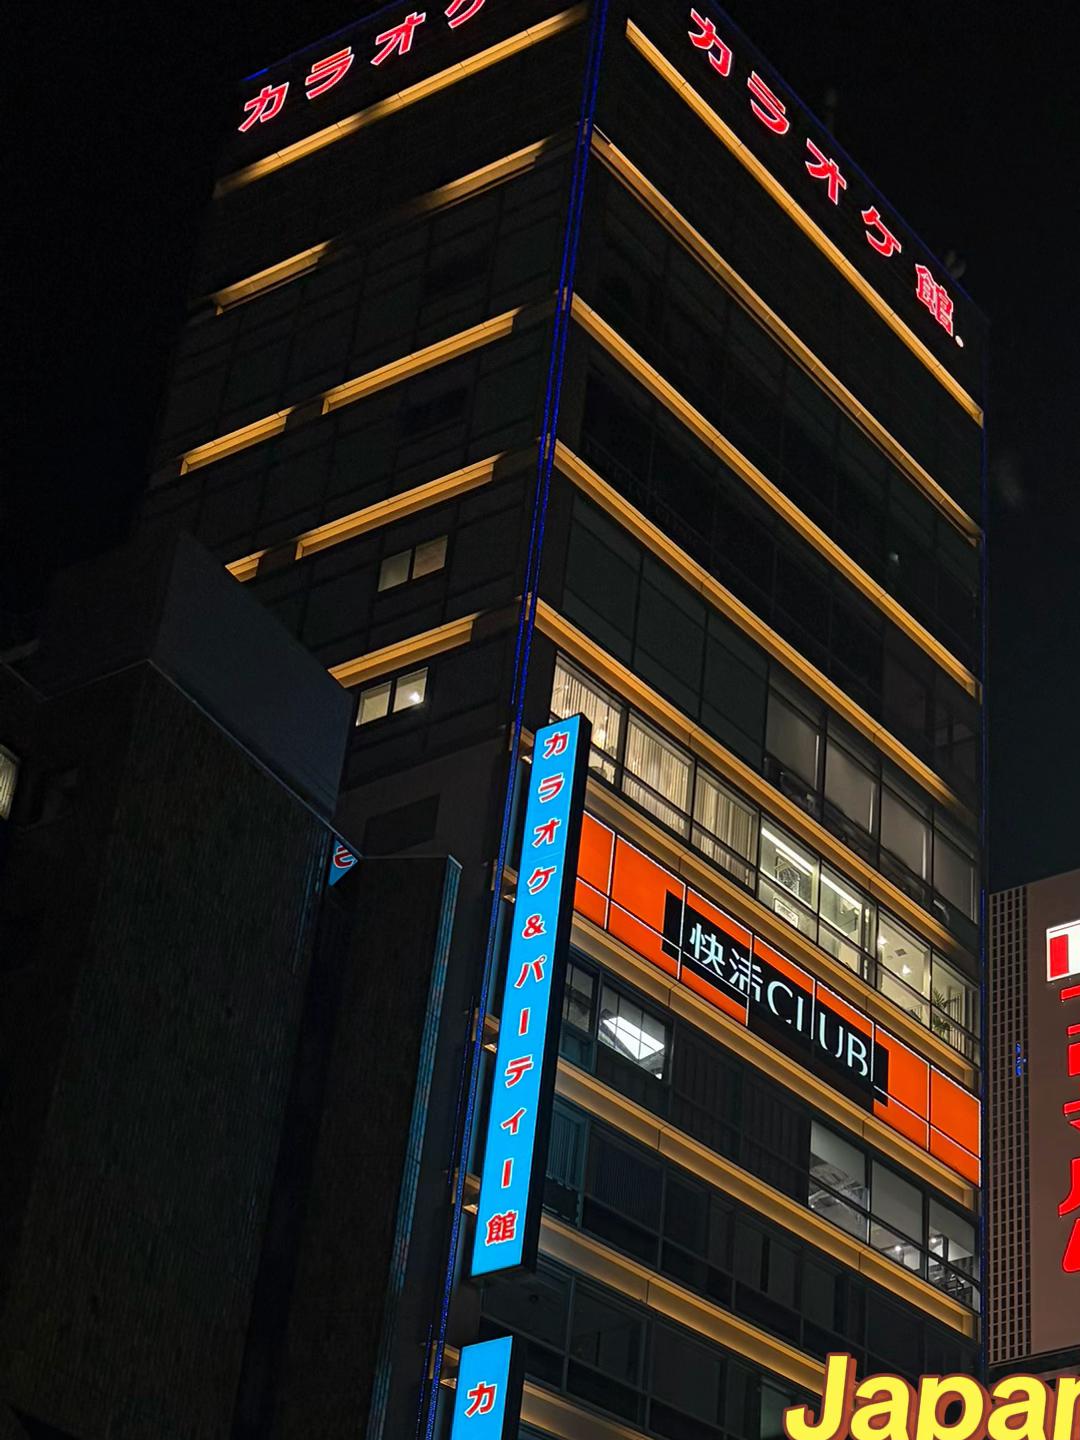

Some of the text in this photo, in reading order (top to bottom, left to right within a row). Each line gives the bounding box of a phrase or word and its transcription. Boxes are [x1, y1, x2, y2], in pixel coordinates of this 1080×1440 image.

[688, 7, 956, 338] カラオケ館
[485, 730, 568, 1246] カラオケ&パーティー館
